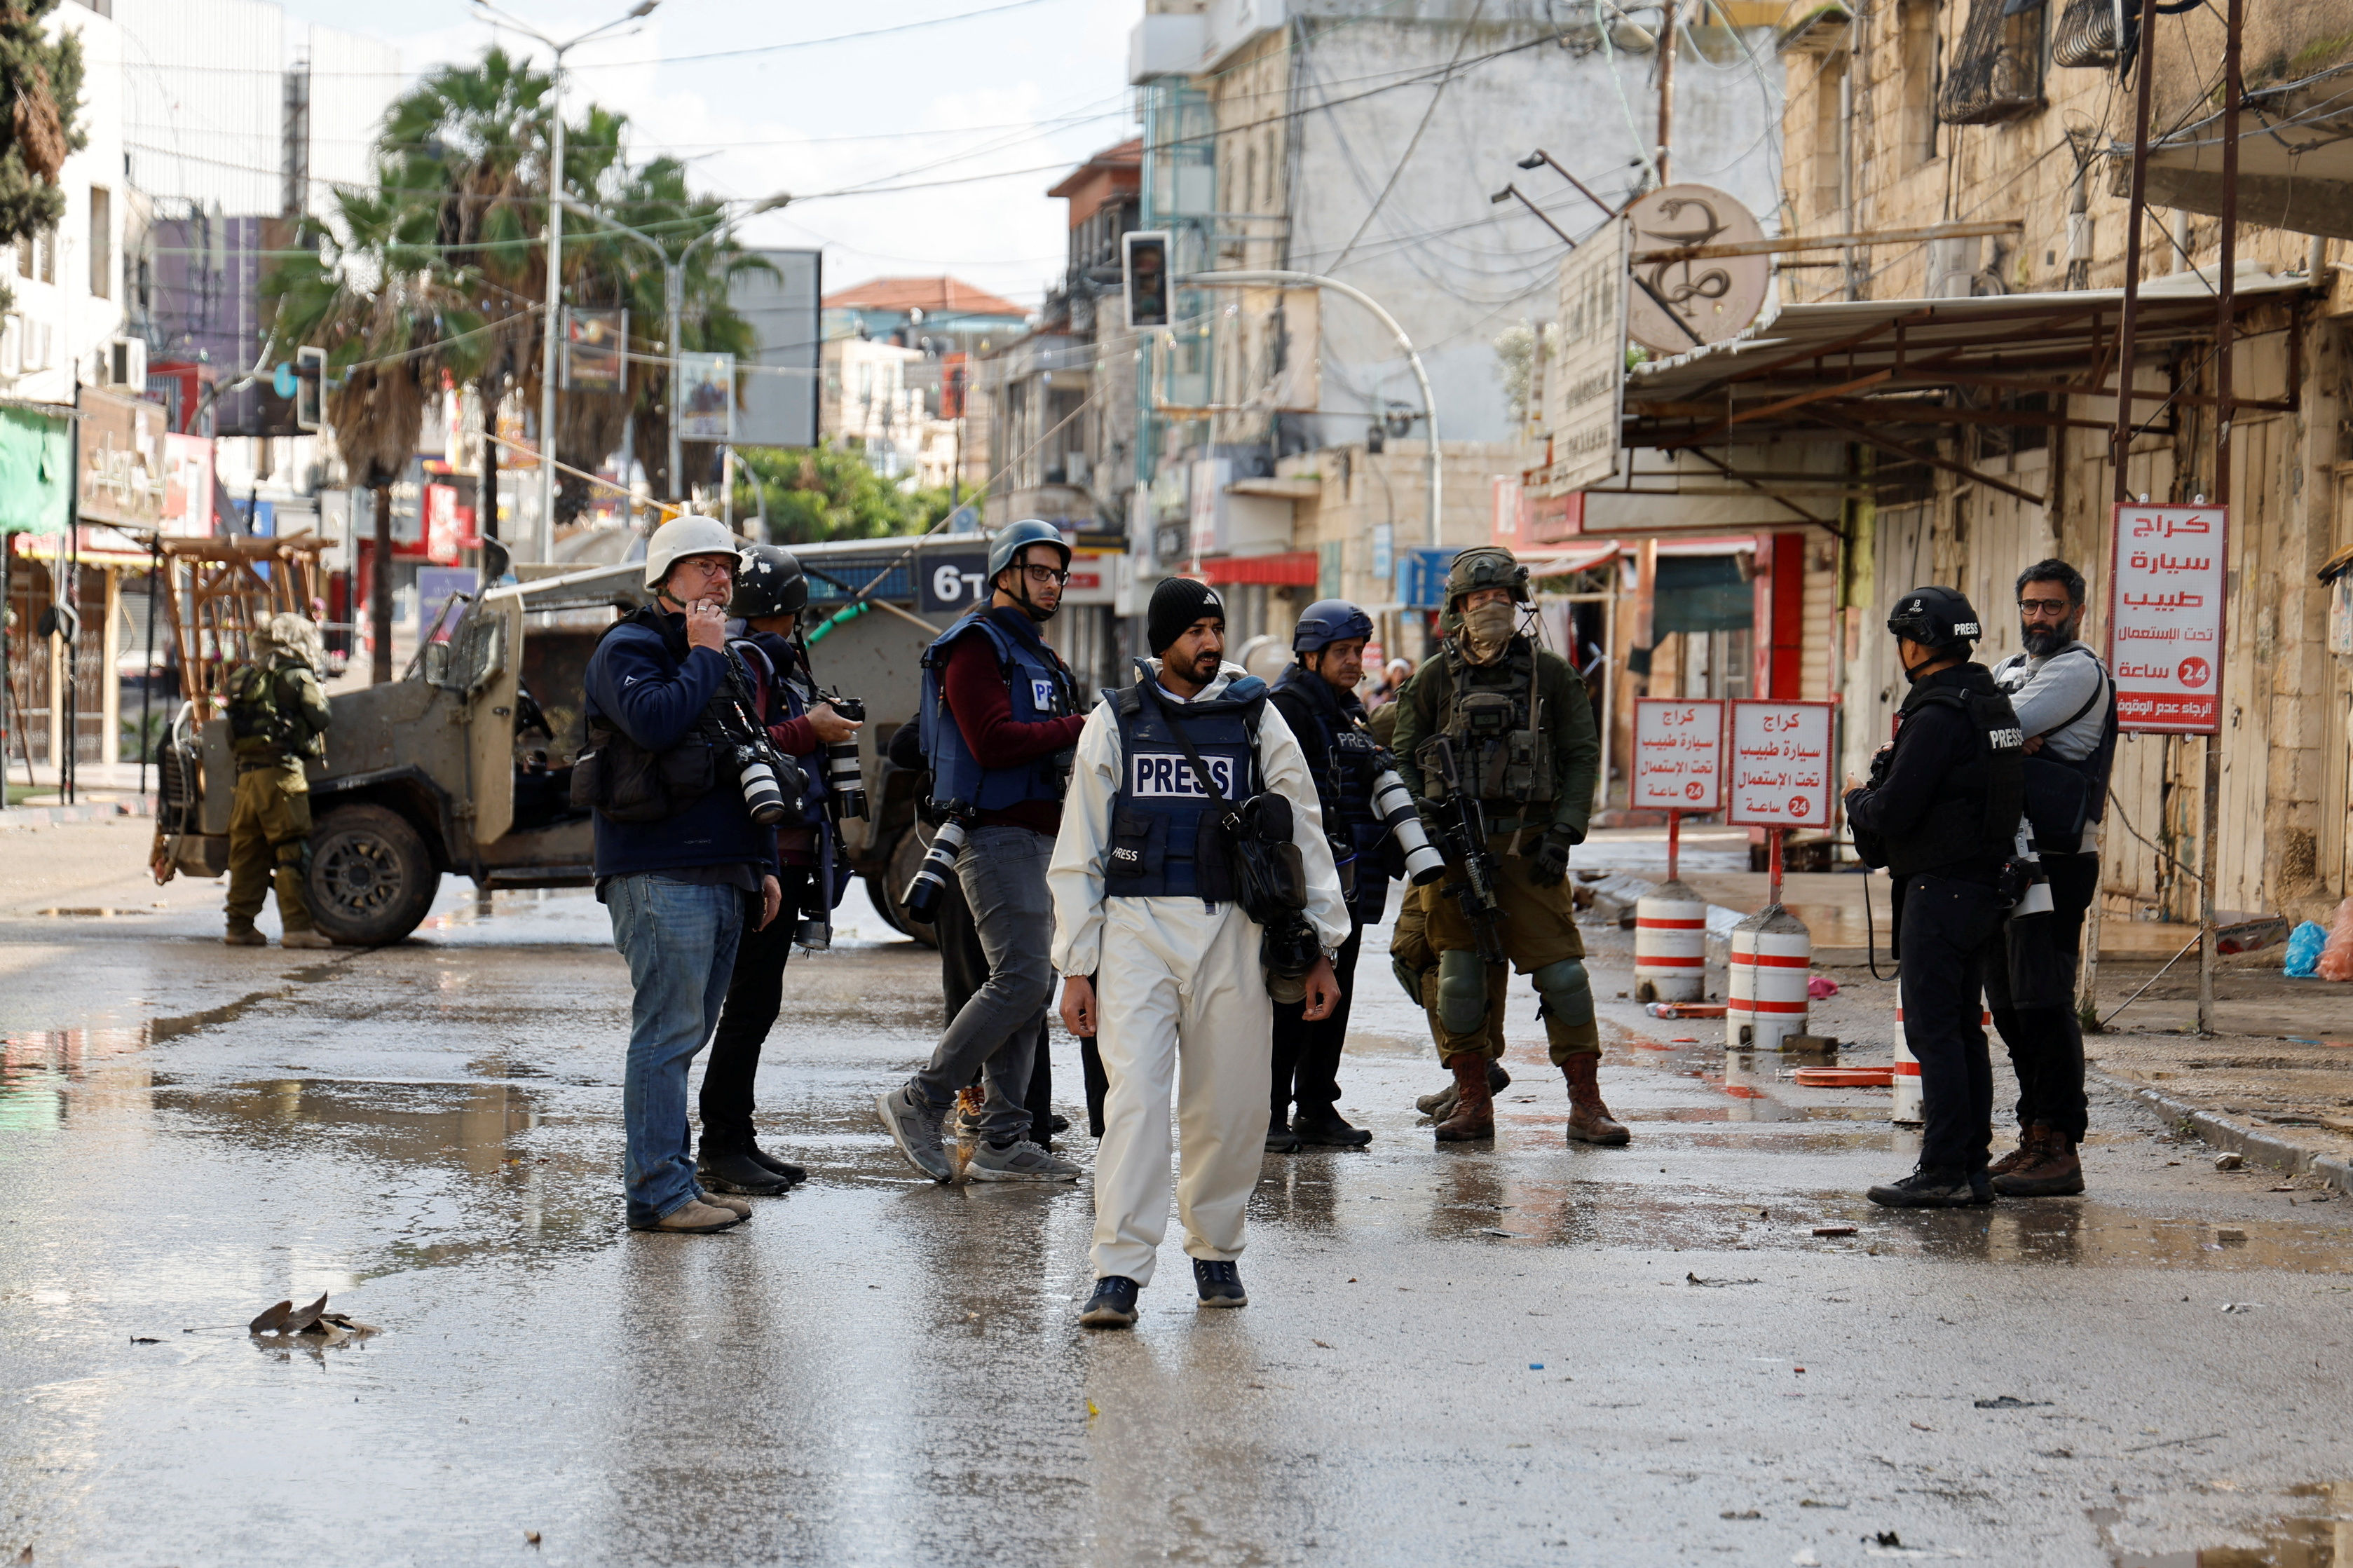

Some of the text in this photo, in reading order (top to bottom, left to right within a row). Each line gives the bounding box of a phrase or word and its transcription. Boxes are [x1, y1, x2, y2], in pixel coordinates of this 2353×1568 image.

[2133, 514, 2210, 538] كراج
[2130, 551, 2210, 574] سيارة
[2123, 591, 2204, 611] طبيب
[1954, 622, 1978, 635] PRESS
[2184, 628, 2213, 641] تحت
[2119, 662, 2207, 681] 24 ساعة
[1663, 708, 1696, 725] كراج
[2155, 703, 2179, 716] عدم
[2181, 702, 2212, 717] الرجاء
[1764, 713, 1800, 732] كراج
[1642, 732, 1714, 751] سيارة طبيب
[1989, 728, 2024, 749] PRESS
[1740, 740, 1821, 761] سيارة طبيب
[1691, 760, 1713, 774] تحت
[1795, 772, 1820, 787] تحت
[1648, 784, 1702, 796] 24 ساعة
[1746, 797, 1807, 812] 24 ساعة
[1112, 847, 1138, 861] PRESS
